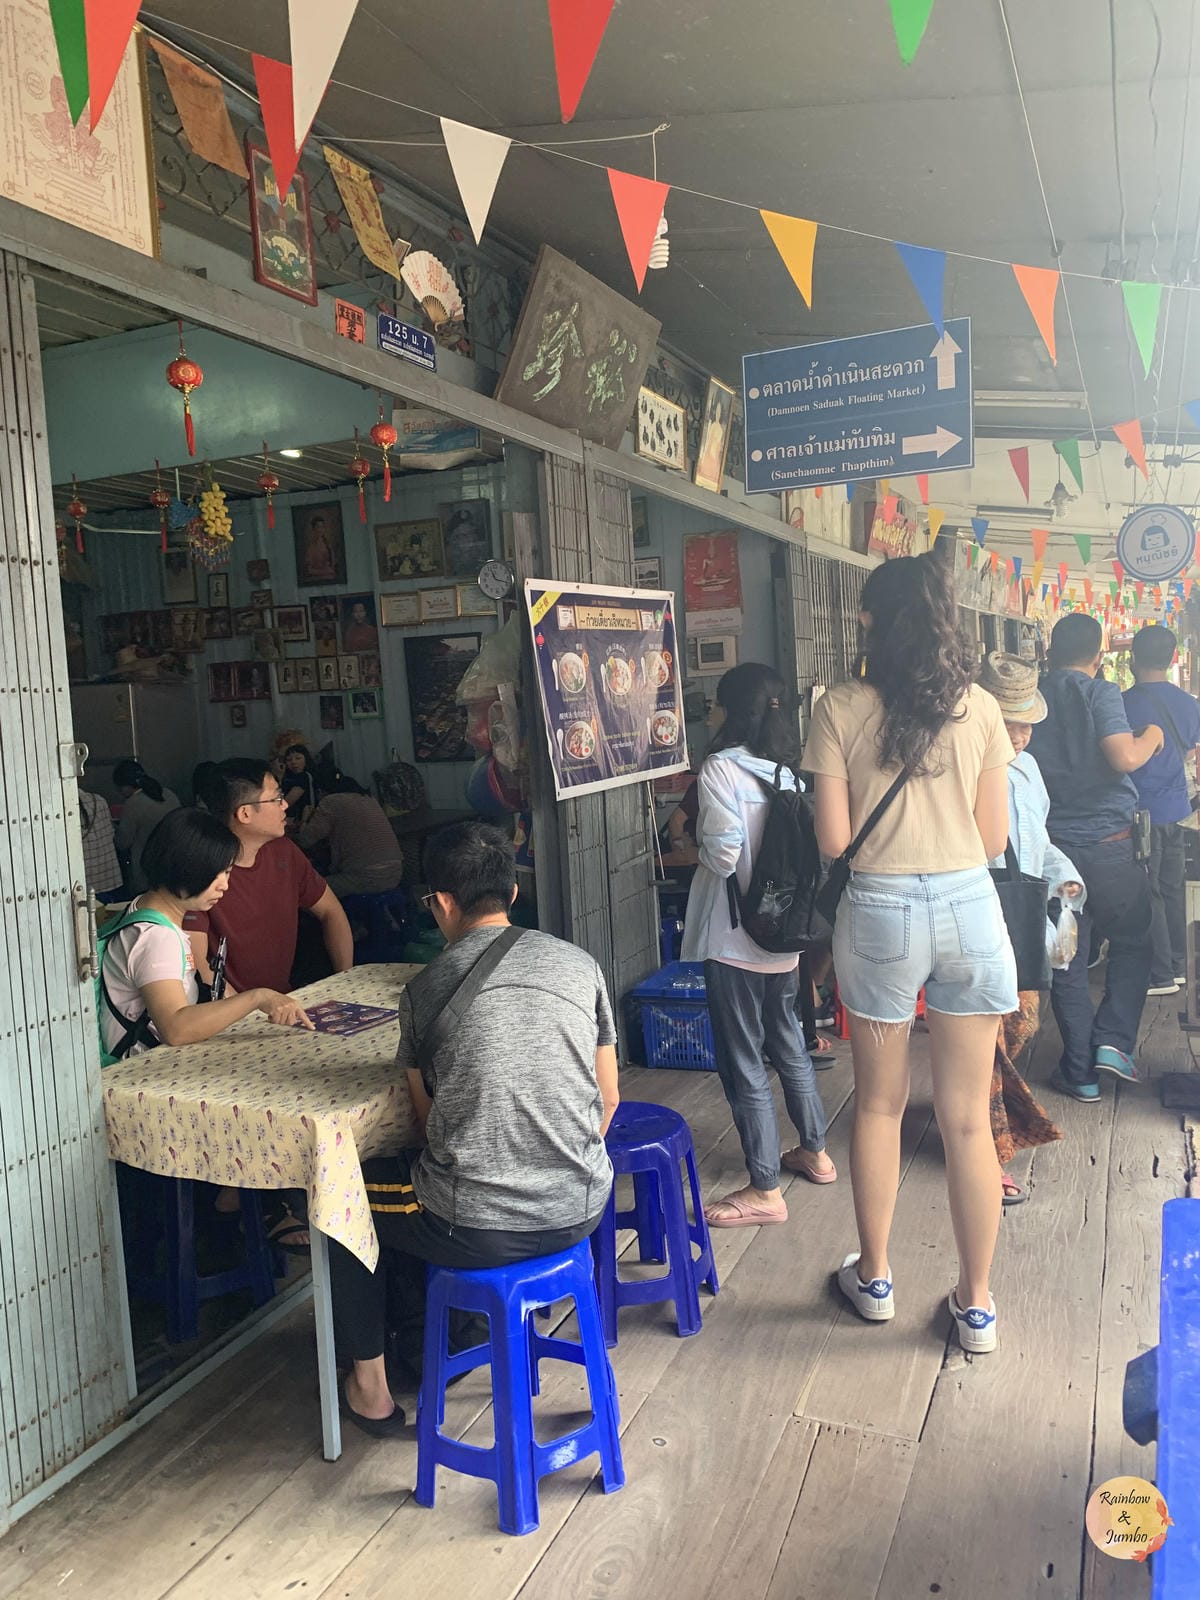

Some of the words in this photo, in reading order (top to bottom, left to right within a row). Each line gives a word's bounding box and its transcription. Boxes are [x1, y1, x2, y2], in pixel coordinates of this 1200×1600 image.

[388, 320, 408, 340] 125
[422, 335, 428, 349] 7
[762, 359, 925, 397] ตลาดน้ำดำเนินสะดวก
[767, 402, 810, 417] (Damnoen
[812, 398, 845, 410] Saduak
[848, 392, 884, 405] Floating
[887, 384, 926, 399] Market)
[766, 427, 896, 461] ศาลเจ้าแม่ทับทิม
